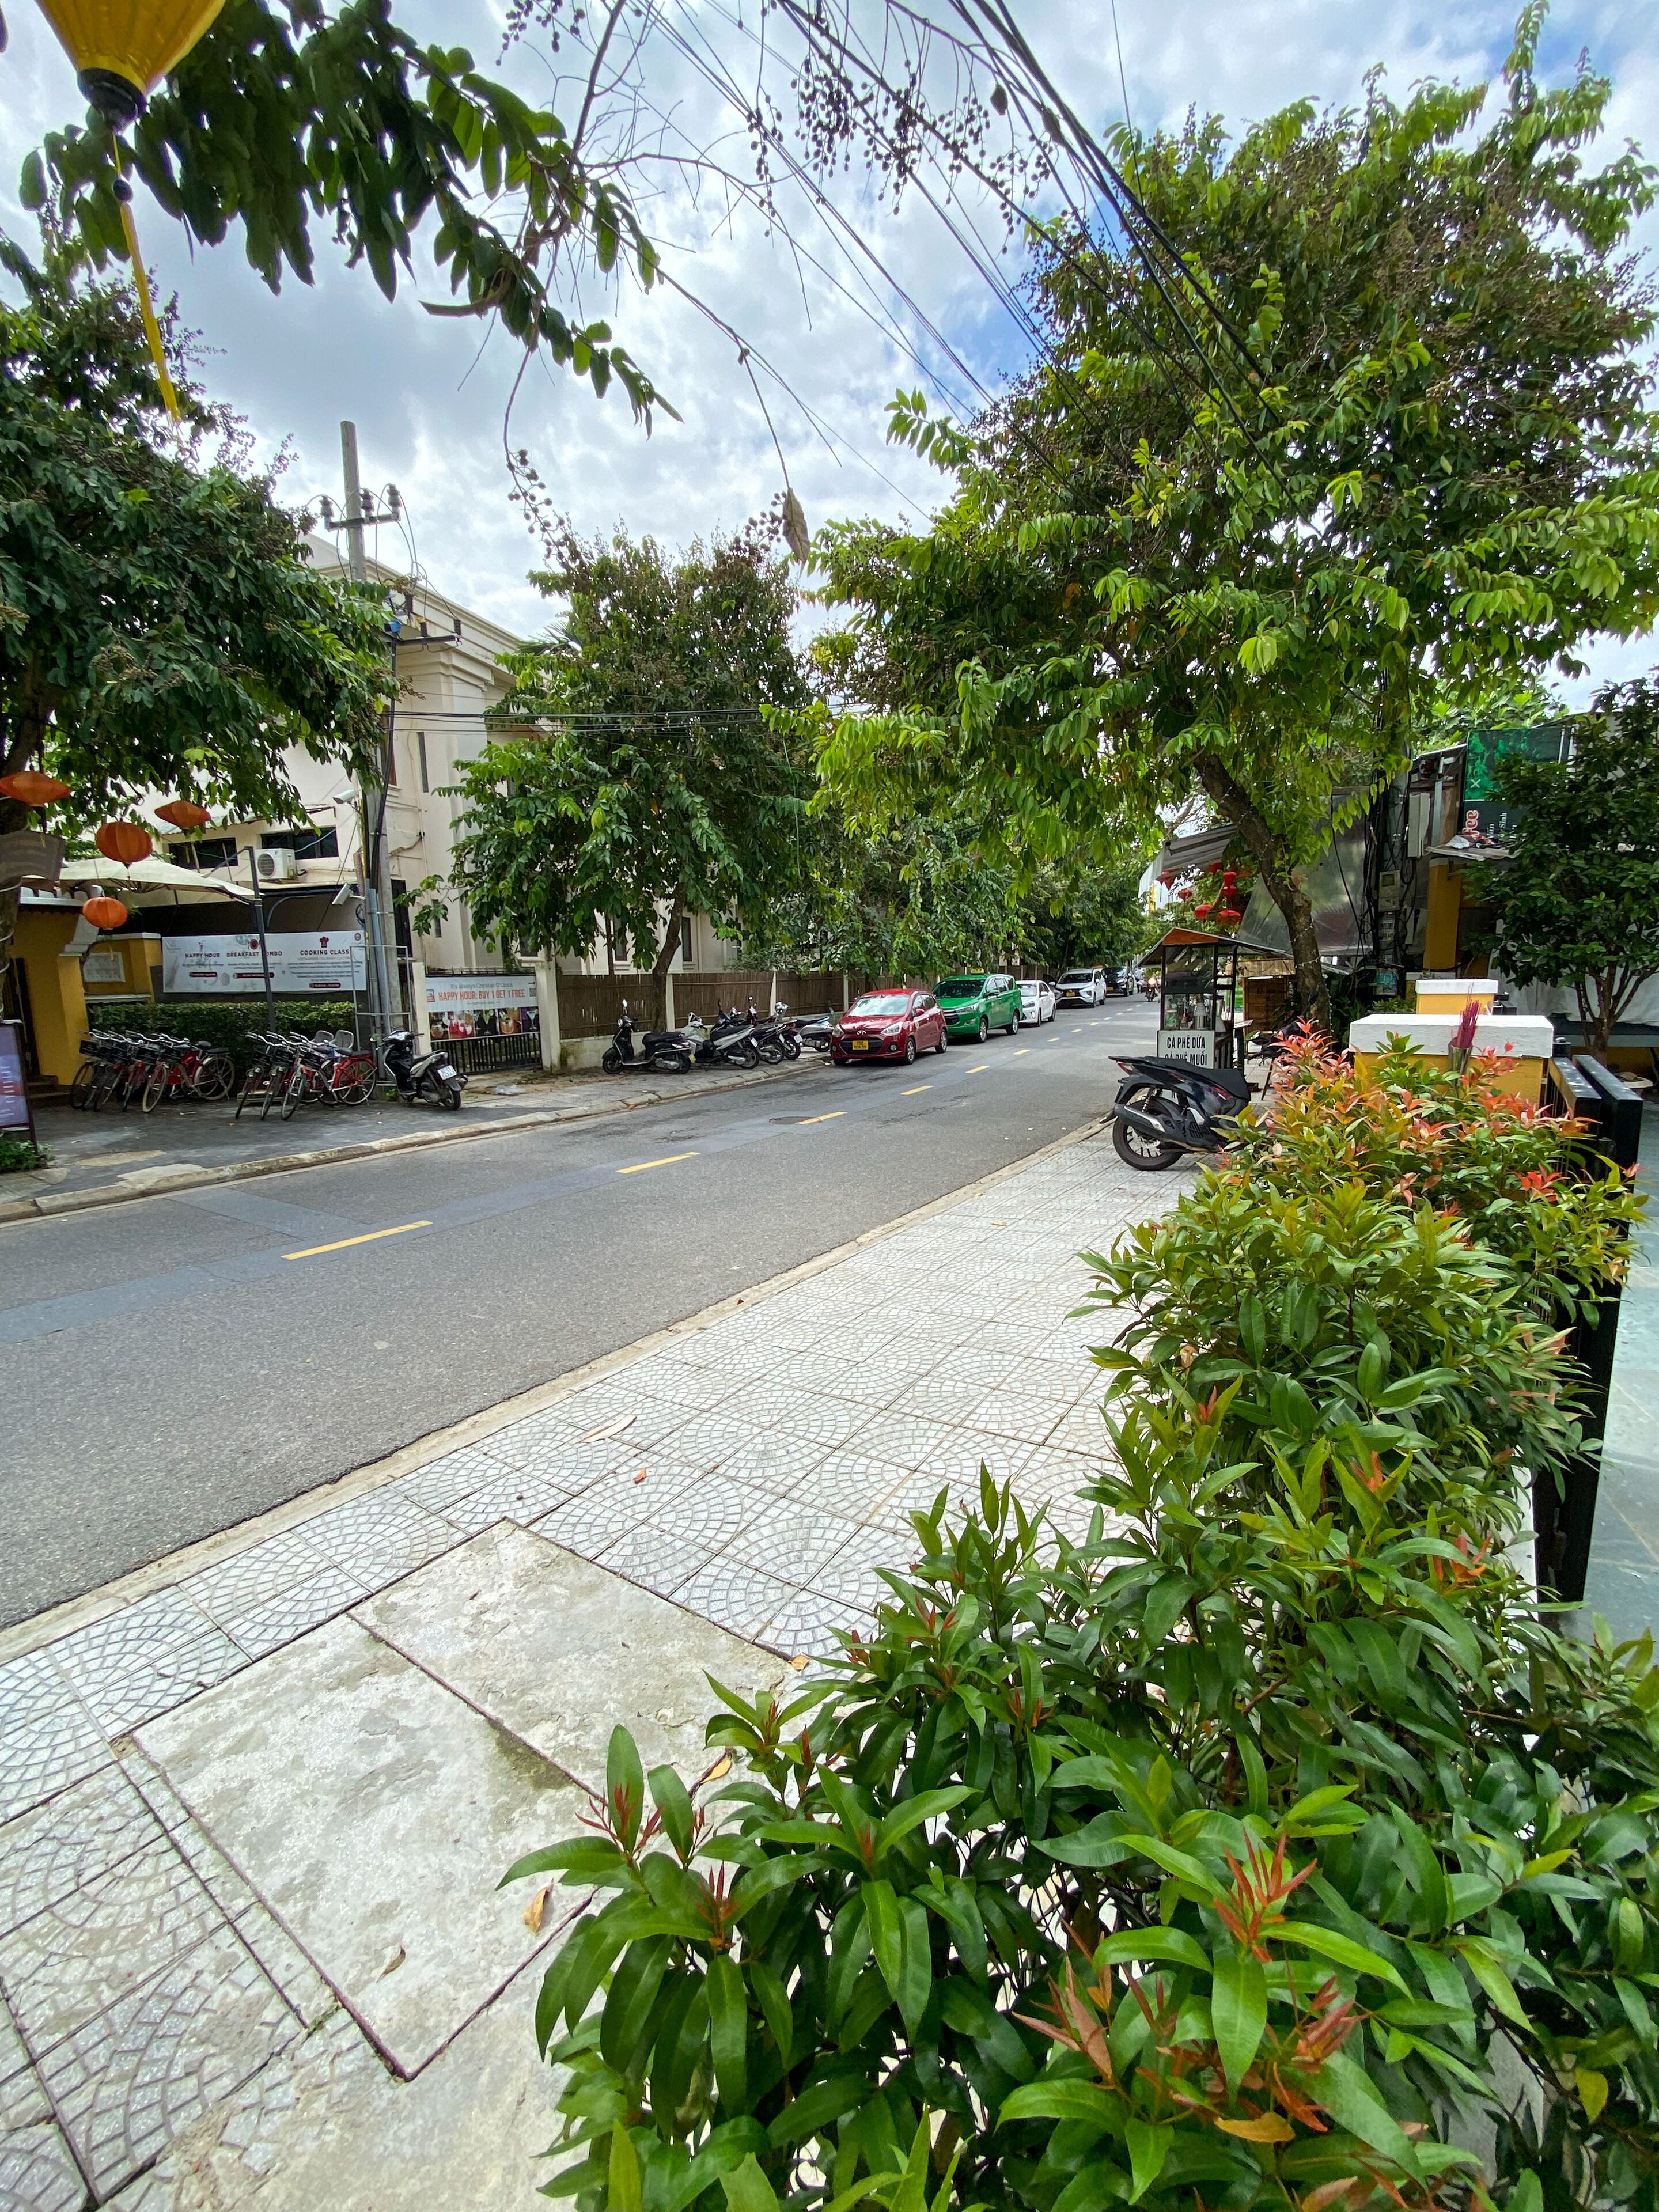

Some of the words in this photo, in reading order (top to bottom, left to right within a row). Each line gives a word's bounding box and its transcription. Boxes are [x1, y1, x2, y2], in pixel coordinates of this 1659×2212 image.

[1462, 810, 1481, 839] fee
[1499, 812, 1507, 829] Sinh
[438, 991, 459, 1001] HAPPY
[460, 990, 477, 1000] HOUR:
[479, 990, 490, 999] BUY
[492, 990, 494, 999] 1
[495, 990, 506, 998] GET
[508, 989, 510, 998] 1
[512, 989, 525, 998] FREE
[1177, 1035, 1190, 1048] PHÊ
